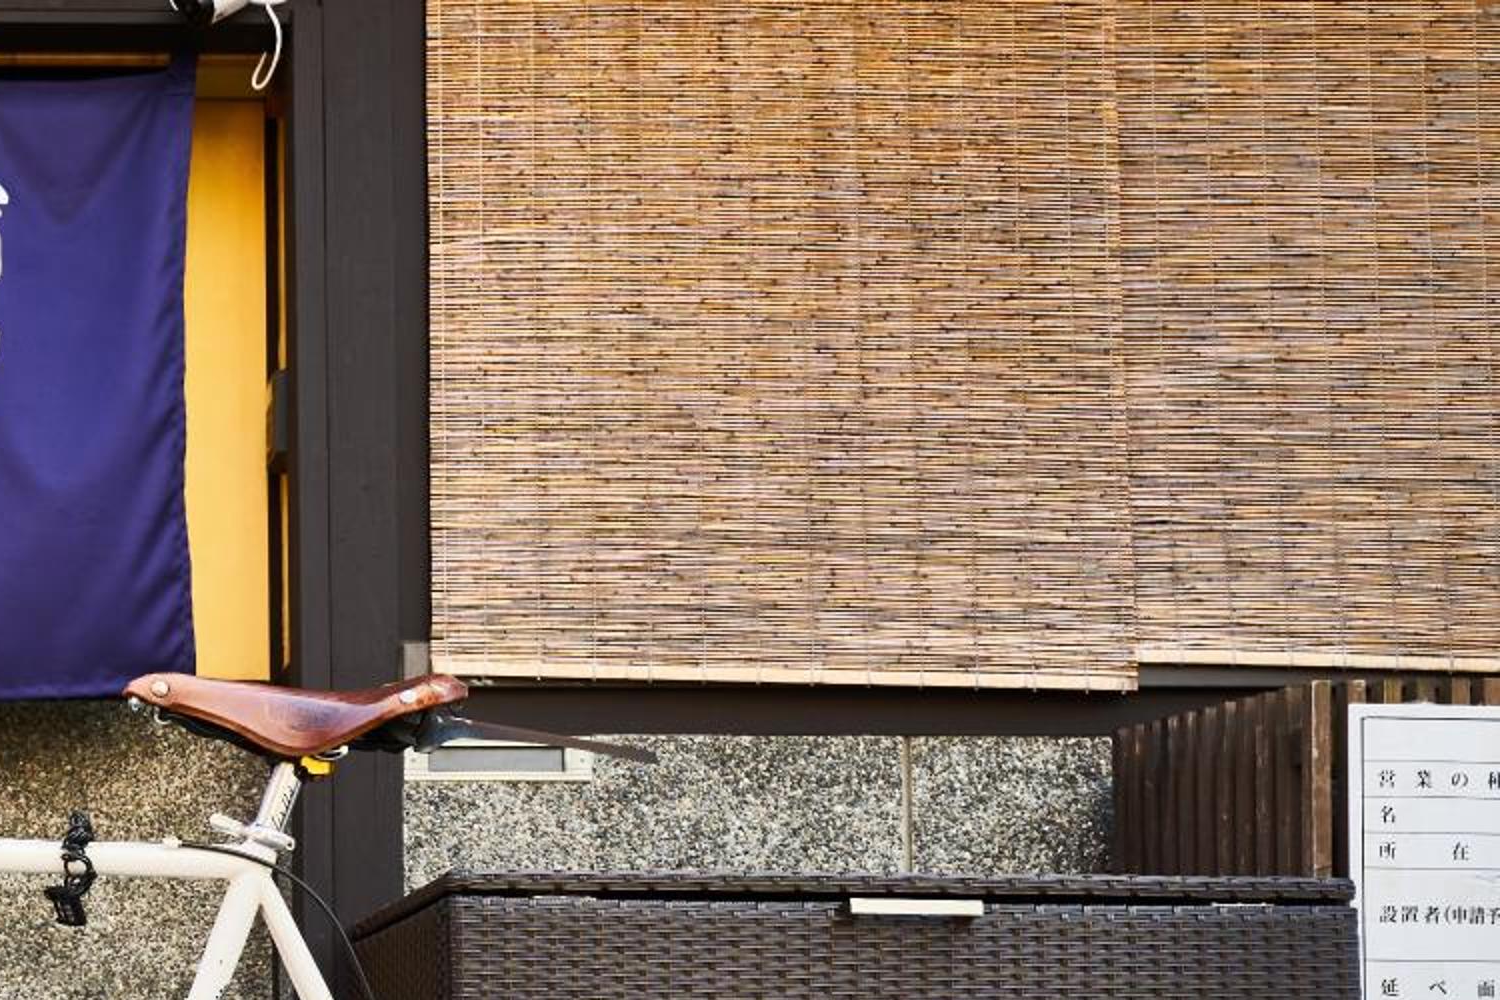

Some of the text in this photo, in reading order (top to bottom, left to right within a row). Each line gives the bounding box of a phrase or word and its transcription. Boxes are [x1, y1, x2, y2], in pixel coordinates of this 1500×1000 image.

[1381, 805, 1396, 824] 名
[1379, 841, 1470, 861] 所在
[1381, 977, 1495, 998] 延べ面
